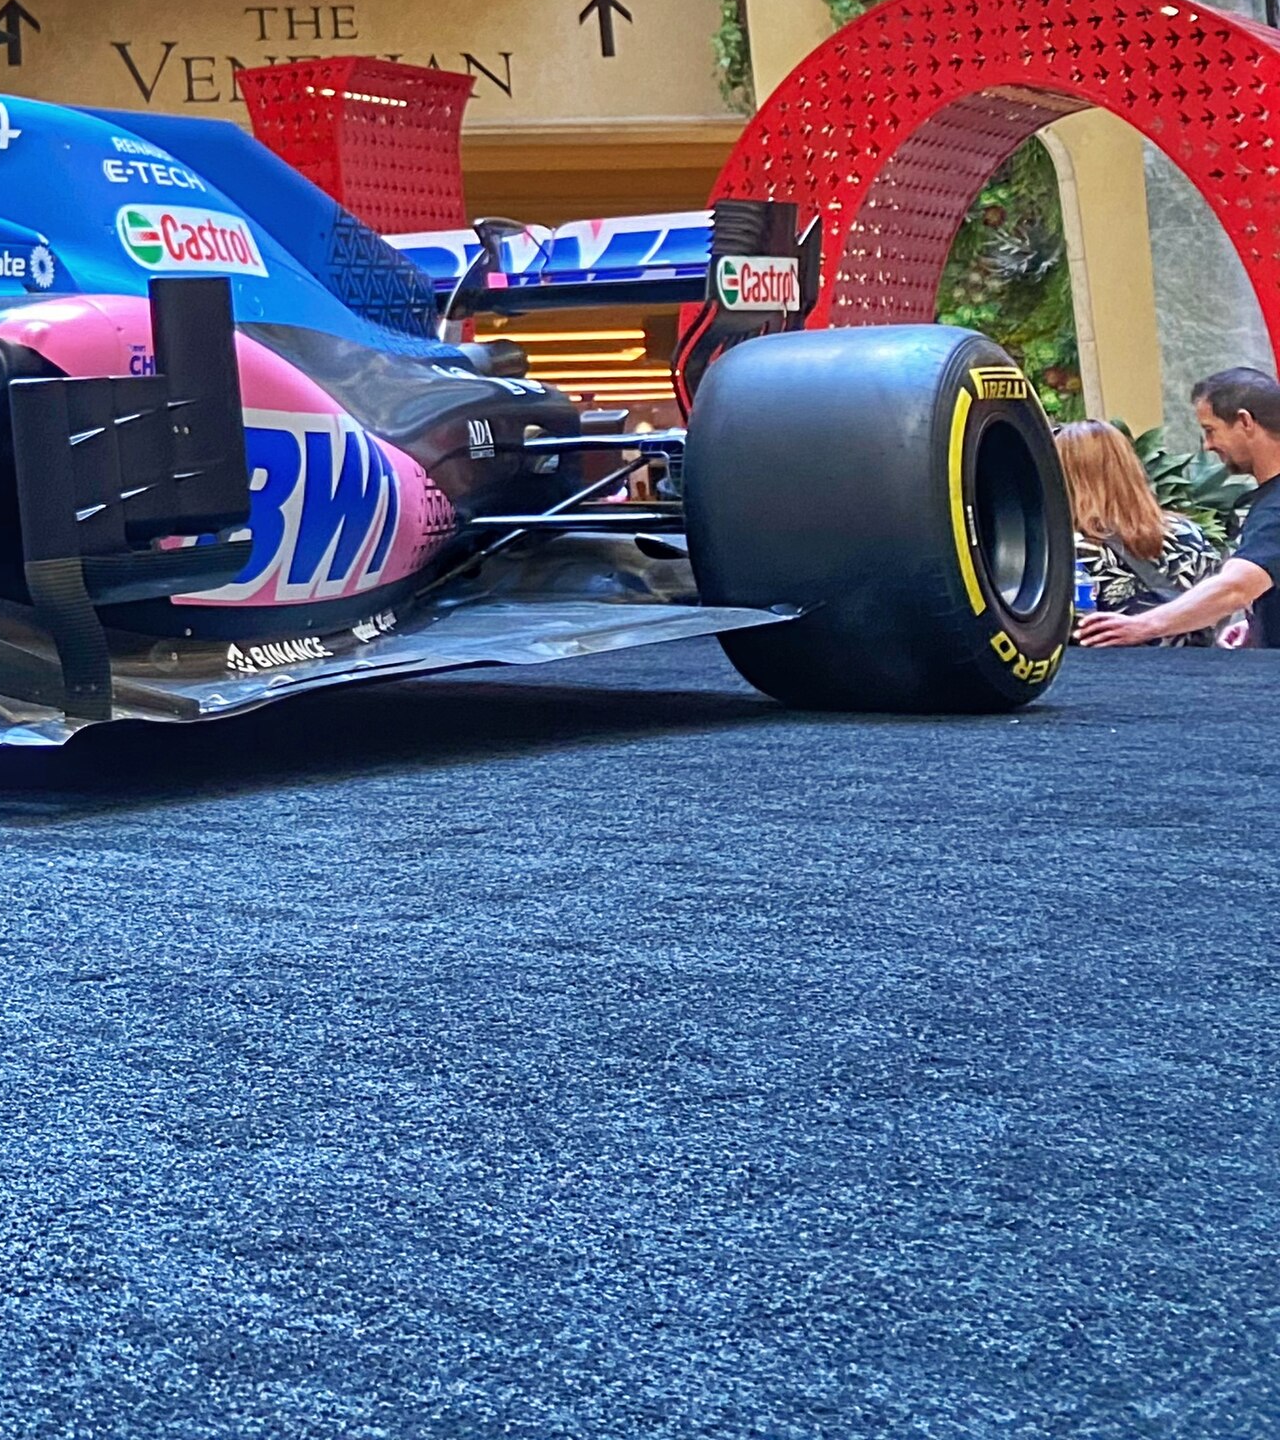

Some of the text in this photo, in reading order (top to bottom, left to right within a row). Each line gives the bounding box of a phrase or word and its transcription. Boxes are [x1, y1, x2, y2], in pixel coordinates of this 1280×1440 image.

[243, 6, 359, 42] THE
[104, 159, 207, 192] E-TECH
[160, 213, 260, 267] Castrol
[740, 264, 796, 304] Castrol
[969, 366, 1028, 400] PIRELLI
[467, 419, 494, 446] ADA
[250, 636, 334, 668] BINANCE
